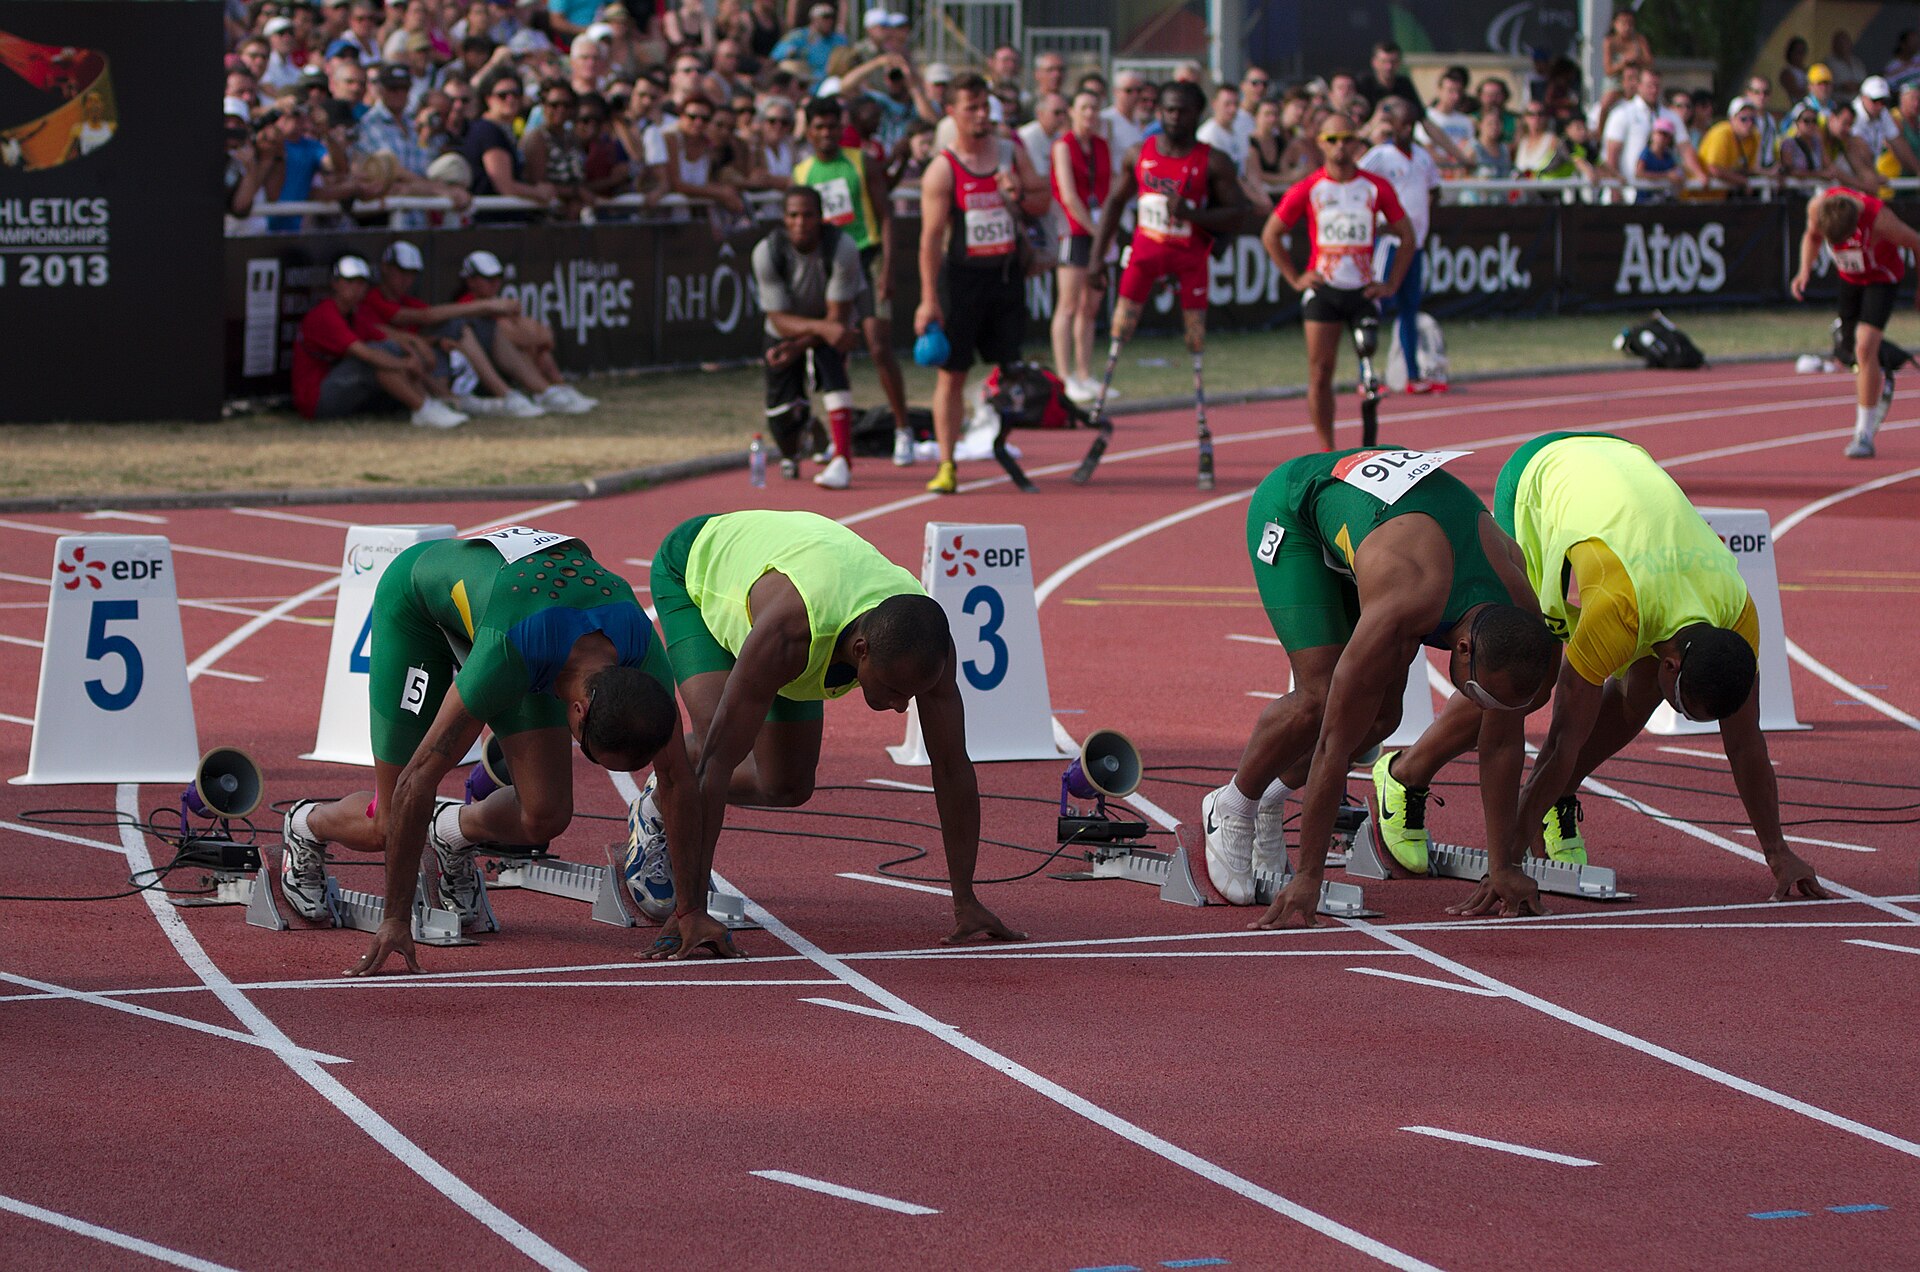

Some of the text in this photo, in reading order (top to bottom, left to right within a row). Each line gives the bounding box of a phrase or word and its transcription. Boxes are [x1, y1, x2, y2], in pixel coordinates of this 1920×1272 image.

[1323, 224, 1368, 241] 0643
[19, 255, 109, 287] 2013
[1421, 232, 1532, 294] bock.
[1260, 530, 1279, 557] 3
[961, 584, 1010, 692] 3
[83, 599, 144, 712] 5
[407, 675, 426, 705] 5
